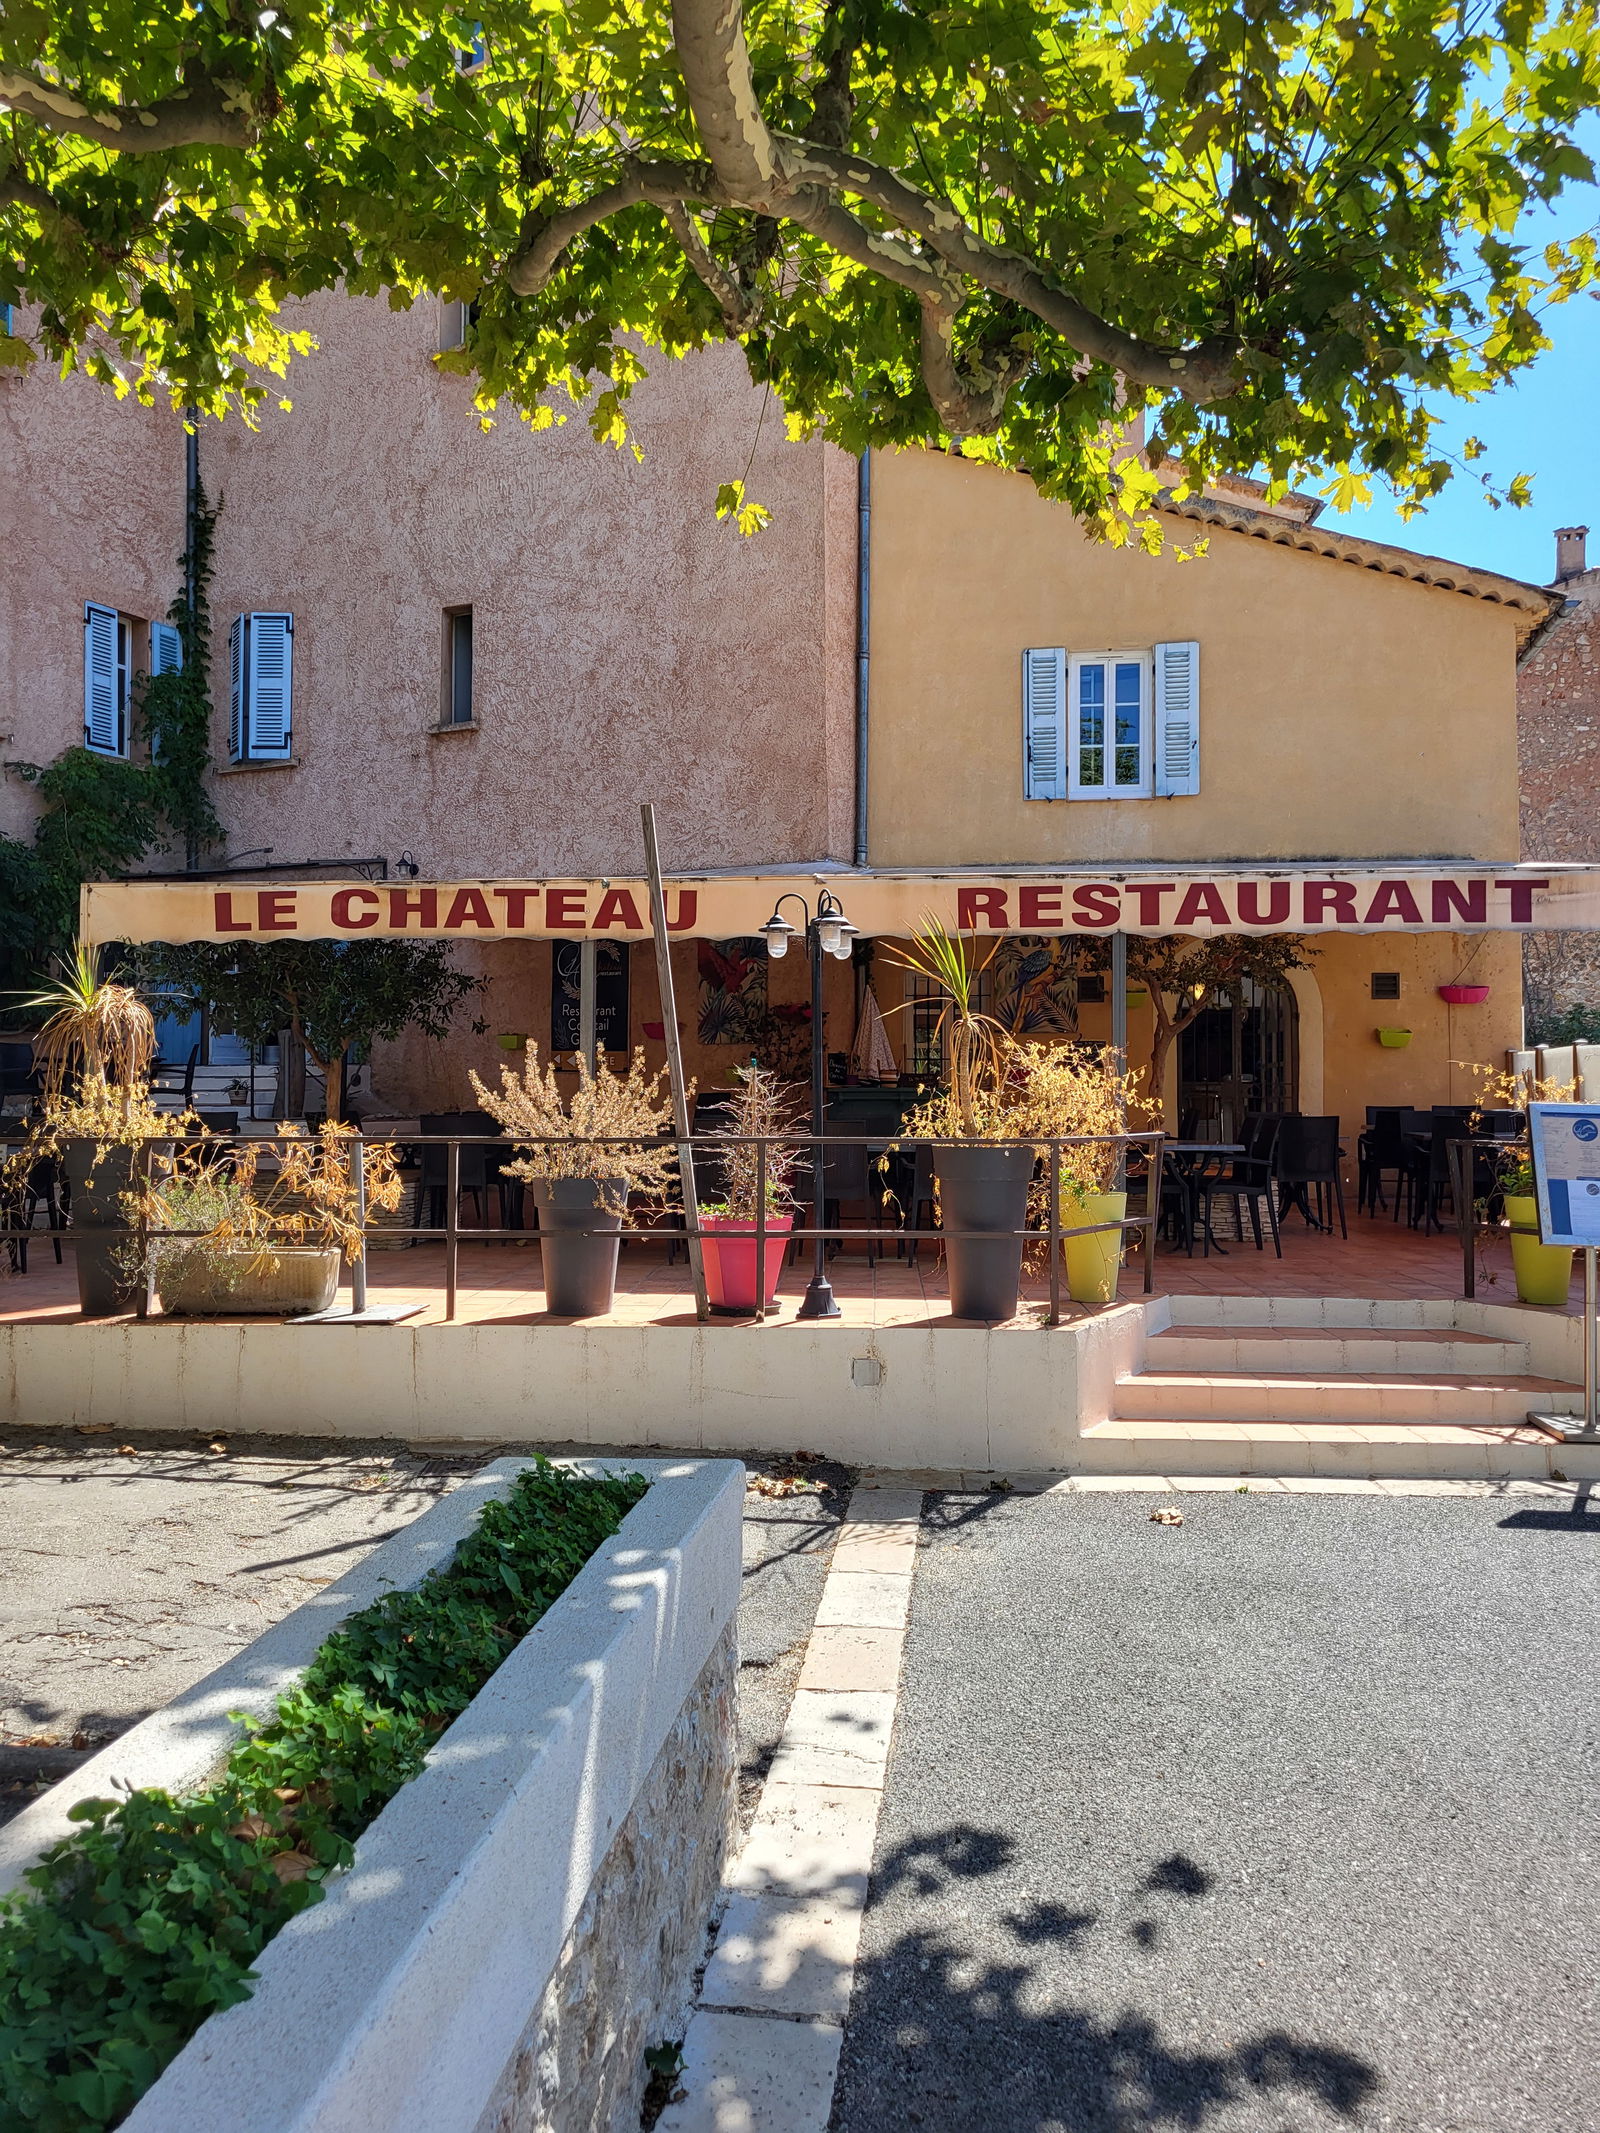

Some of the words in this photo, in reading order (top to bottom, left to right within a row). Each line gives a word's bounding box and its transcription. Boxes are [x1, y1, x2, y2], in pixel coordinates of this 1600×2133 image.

[215, 891, 297, 931] LE
[331, 889, 697, 931] CHATEAU
[958, 879, 1549, 929] RESTAURANT
[562, 1004, 616, 1016] Resrant
